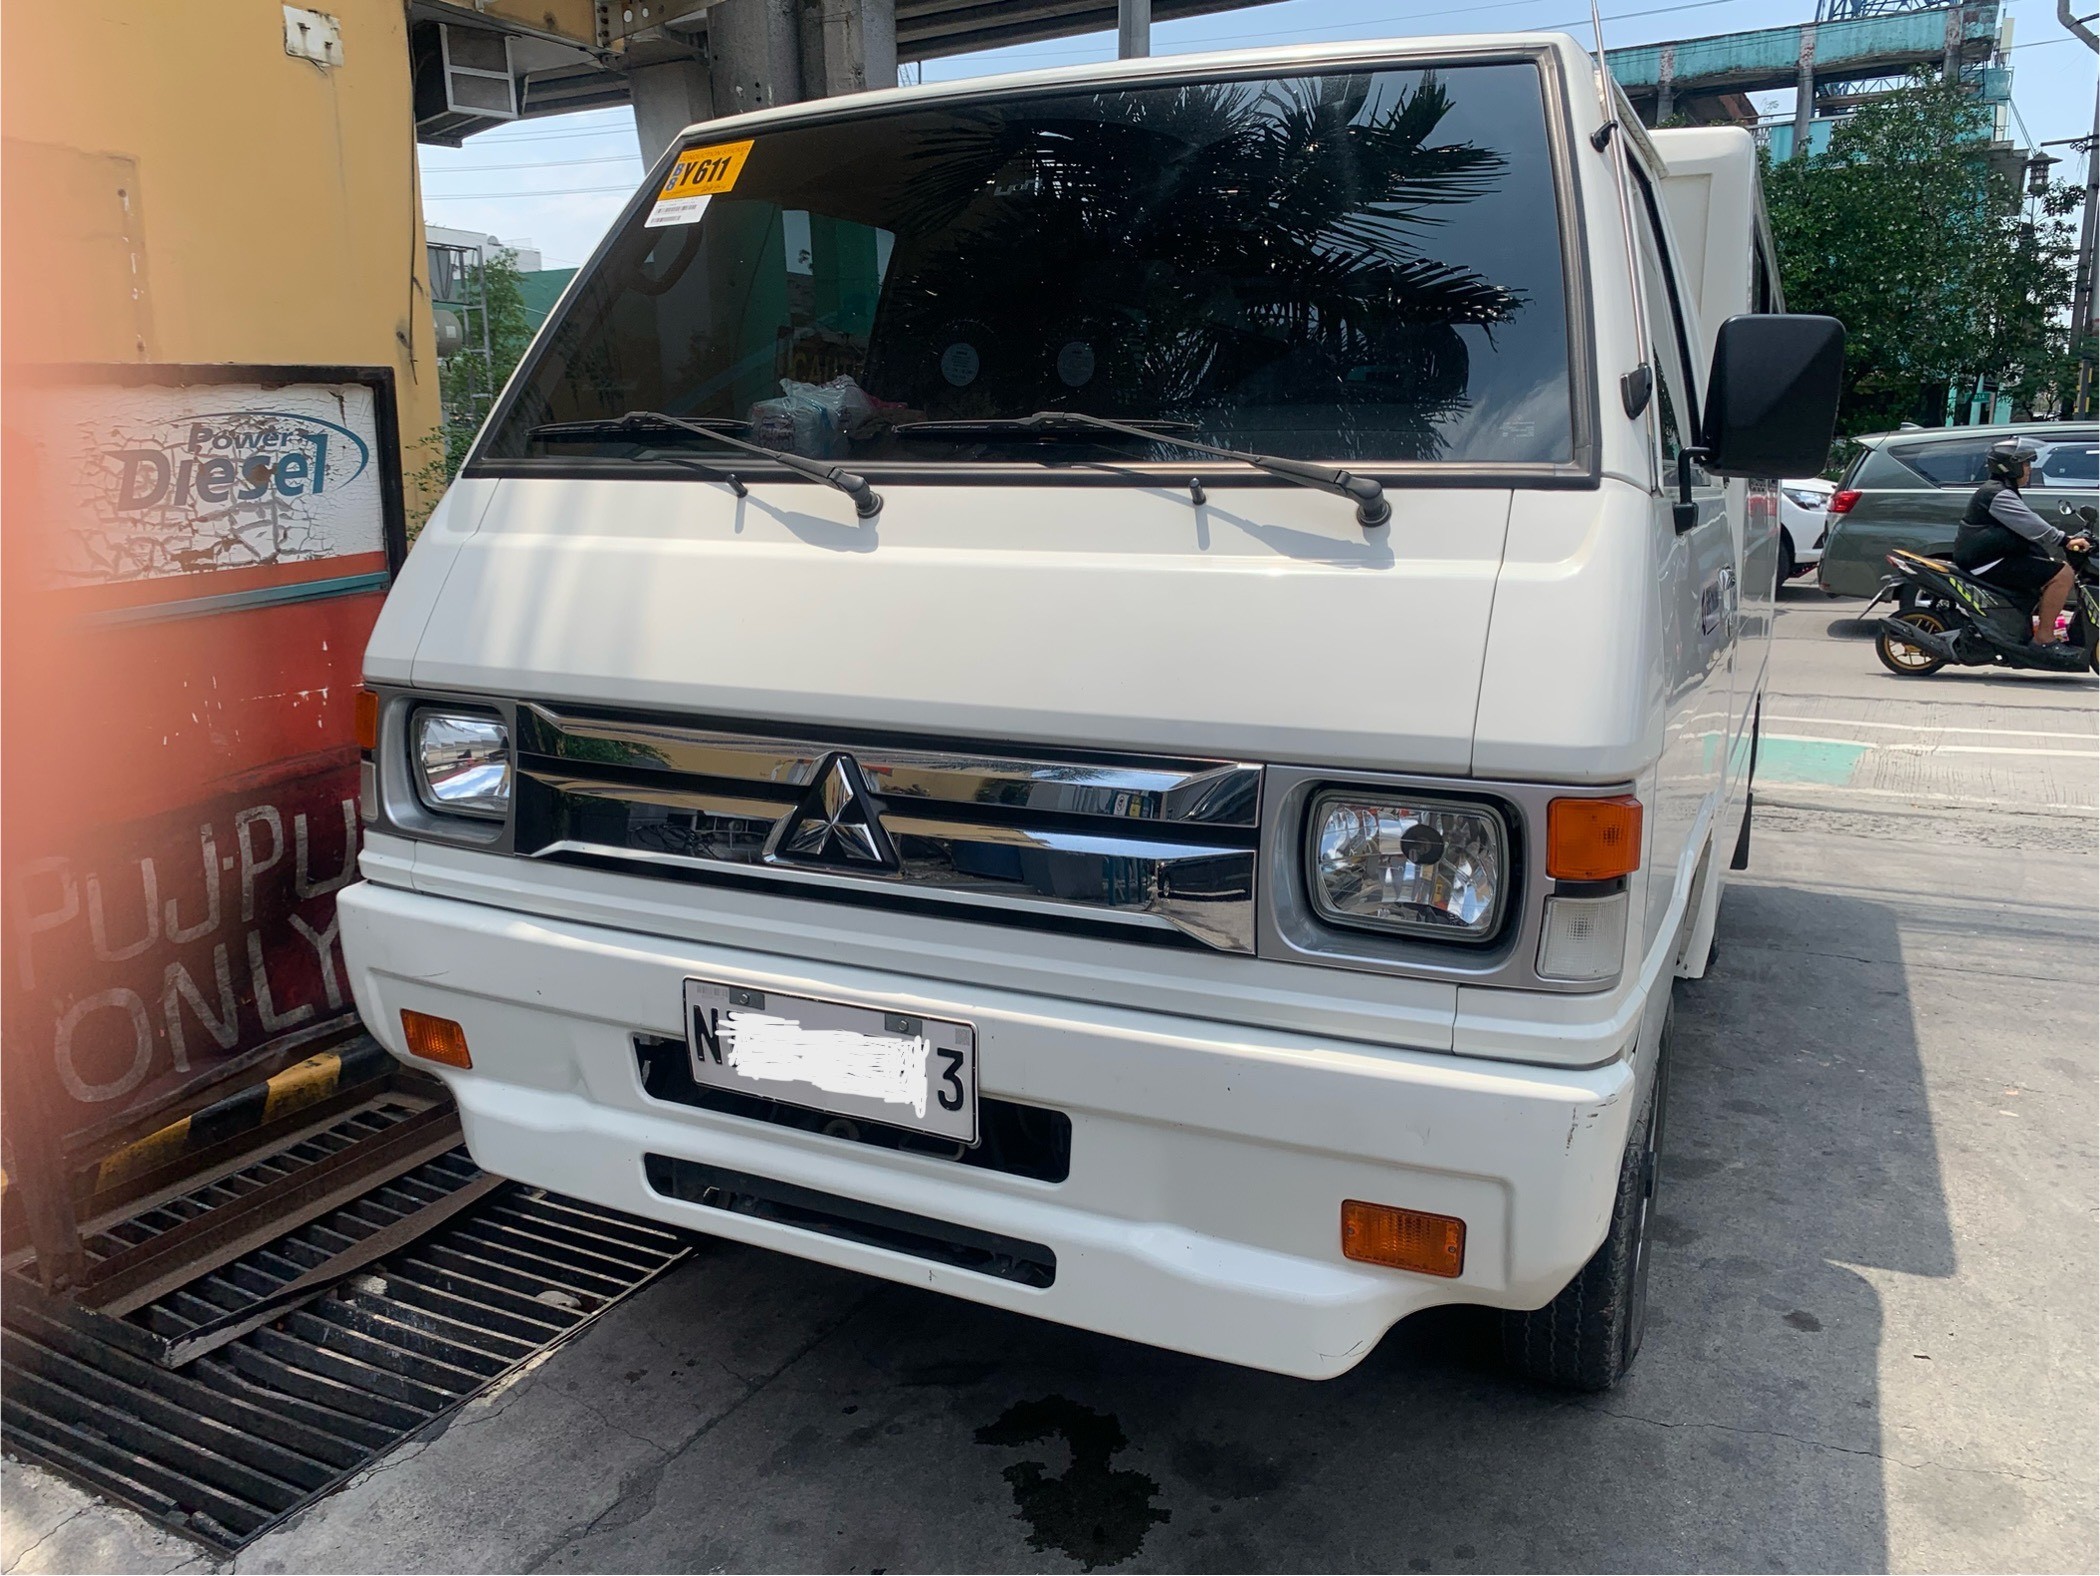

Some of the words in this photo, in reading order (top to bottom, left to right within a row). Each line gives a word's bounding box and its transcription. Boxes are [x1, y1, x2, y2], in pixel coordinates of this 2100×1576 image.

[680, 156, 733, 186] Y611
[187, 422, 297, 452] Power
[54, 908, 344, 1102] ONLY
